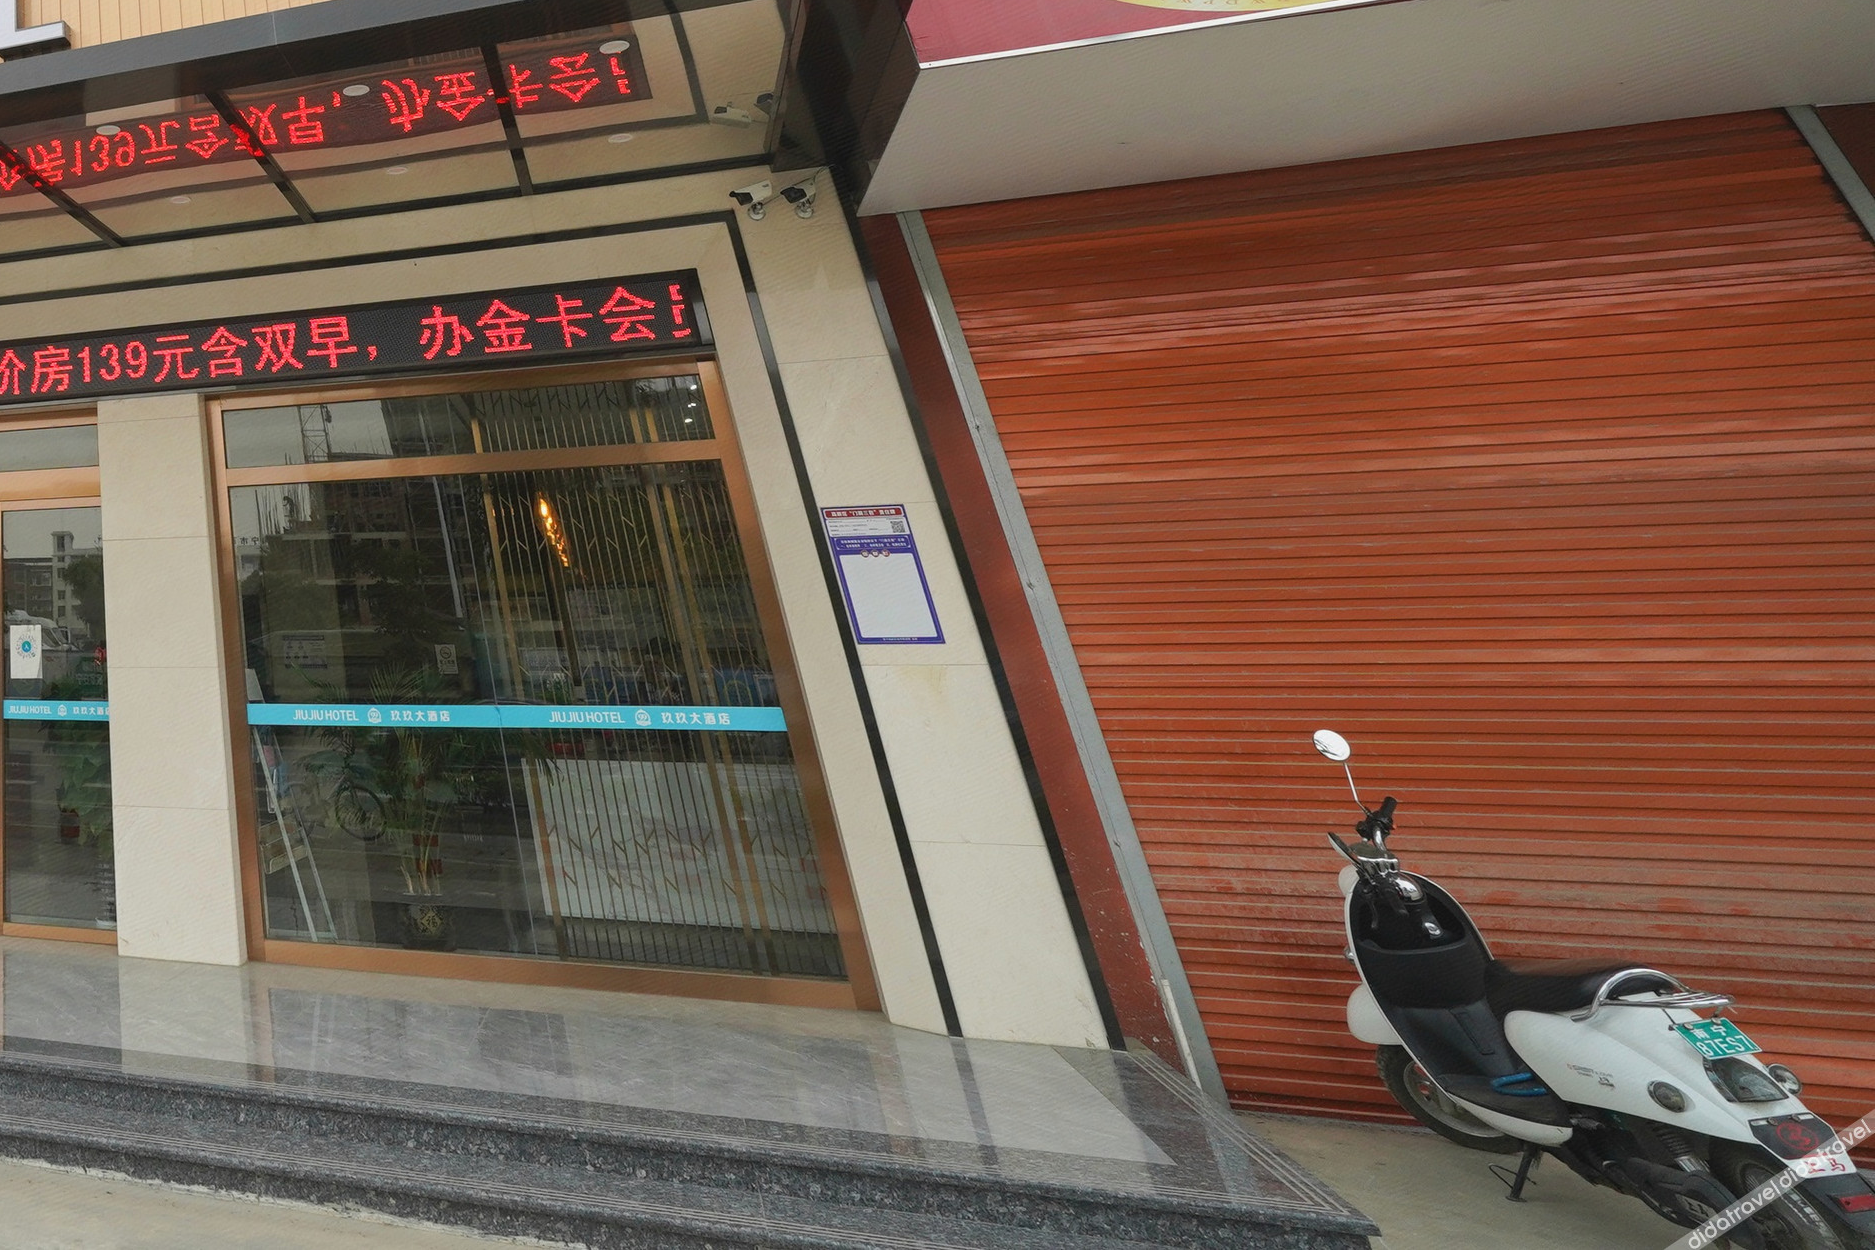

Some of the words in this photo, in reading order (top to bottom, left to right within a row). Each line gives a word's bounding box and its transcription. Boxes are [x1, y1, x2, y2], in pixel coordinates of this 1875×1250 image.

[292, 709, 324, 721] JIUJIU
[325, 710, 359, 722] HOTEL
[390, 710, 451, 722] 玖玖大酒店
[549, 711, 584, 723] JIUJIU
[585, 711, 625, 724] HOTEL
[661, 712, 731, 725] 玖玖大酒店
[1691, 1024, 1727, 1040] 南宁
[1695, 1034, 1756, 1057] 87ES7
